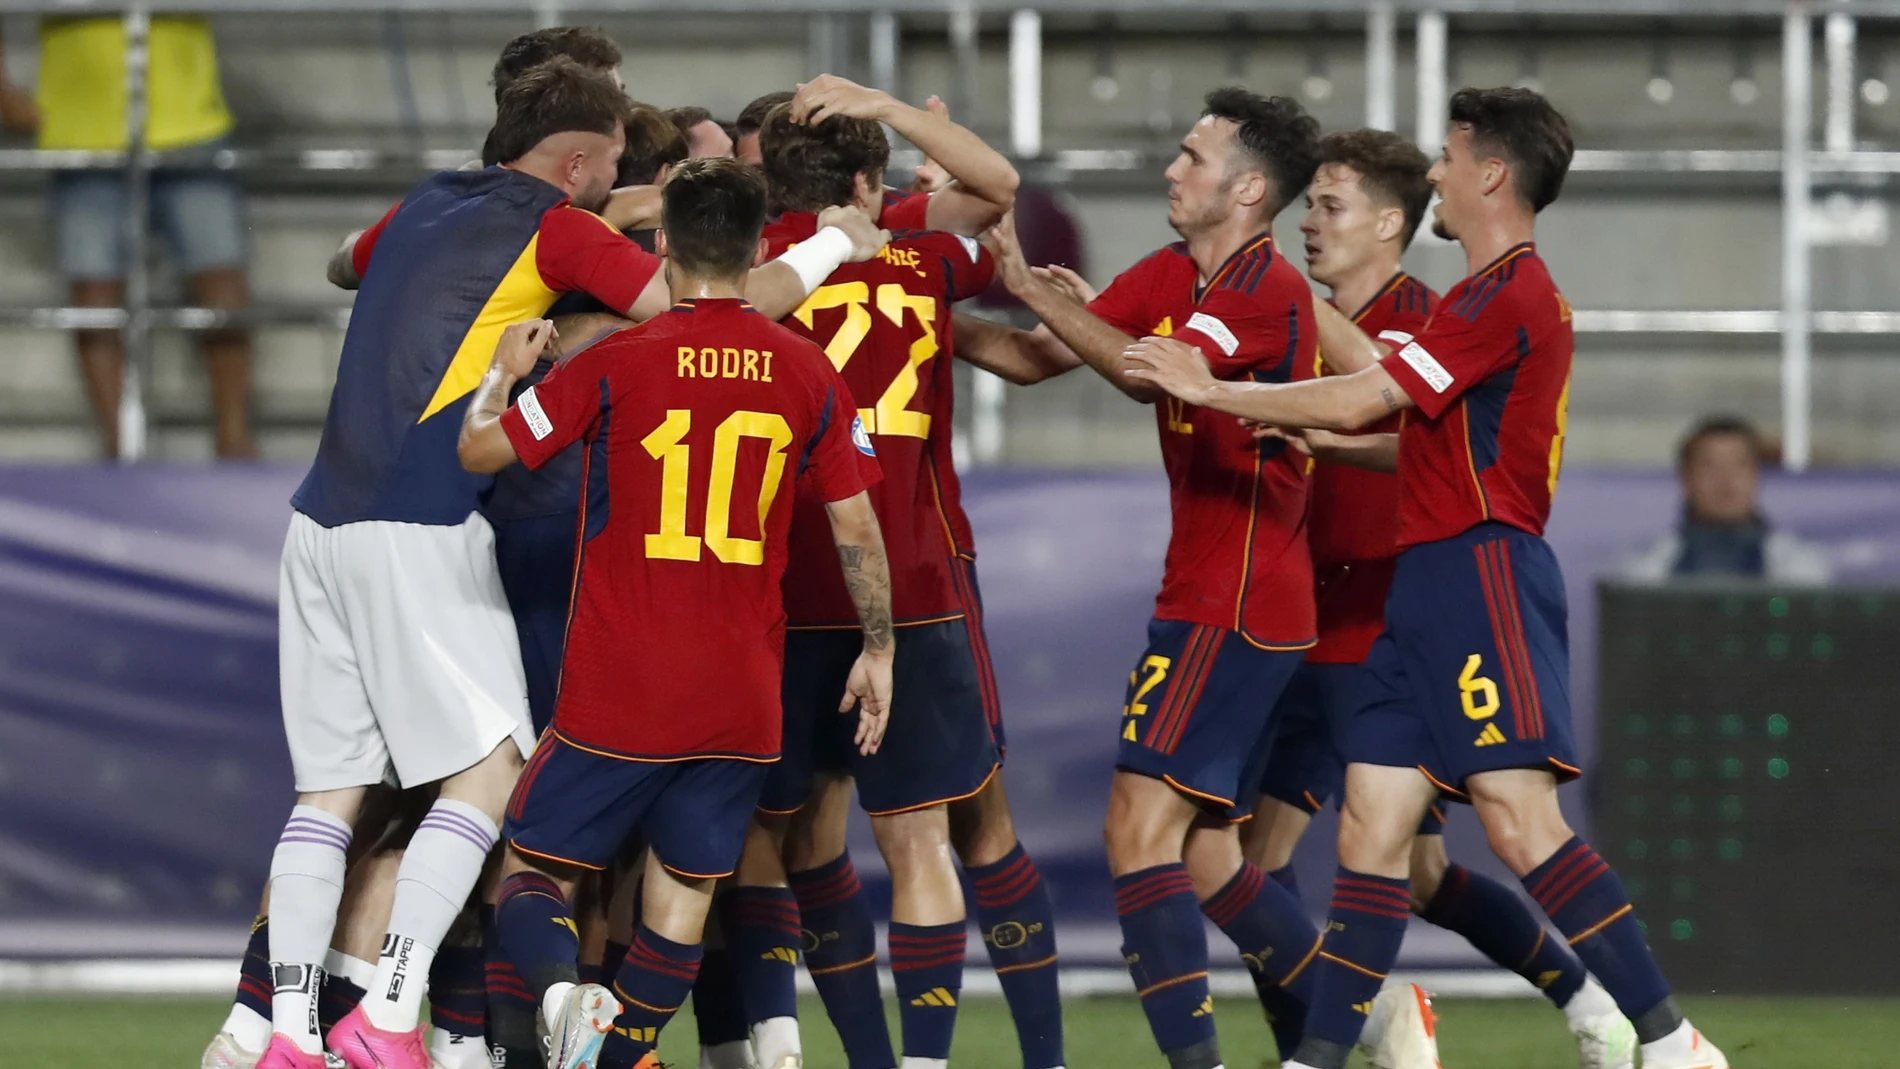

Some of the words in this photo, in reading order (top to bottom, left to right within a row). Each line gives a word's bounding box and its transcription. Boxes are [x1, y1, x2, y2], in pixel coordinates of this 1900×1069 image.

[677, 346, 773, 383] RODRI
[793, 281, 939, 438] 22
[640, 409, 794, 566] 10
[1458, 654, 1501, 720] 6
[397, 936, 415, 972] TAPED
